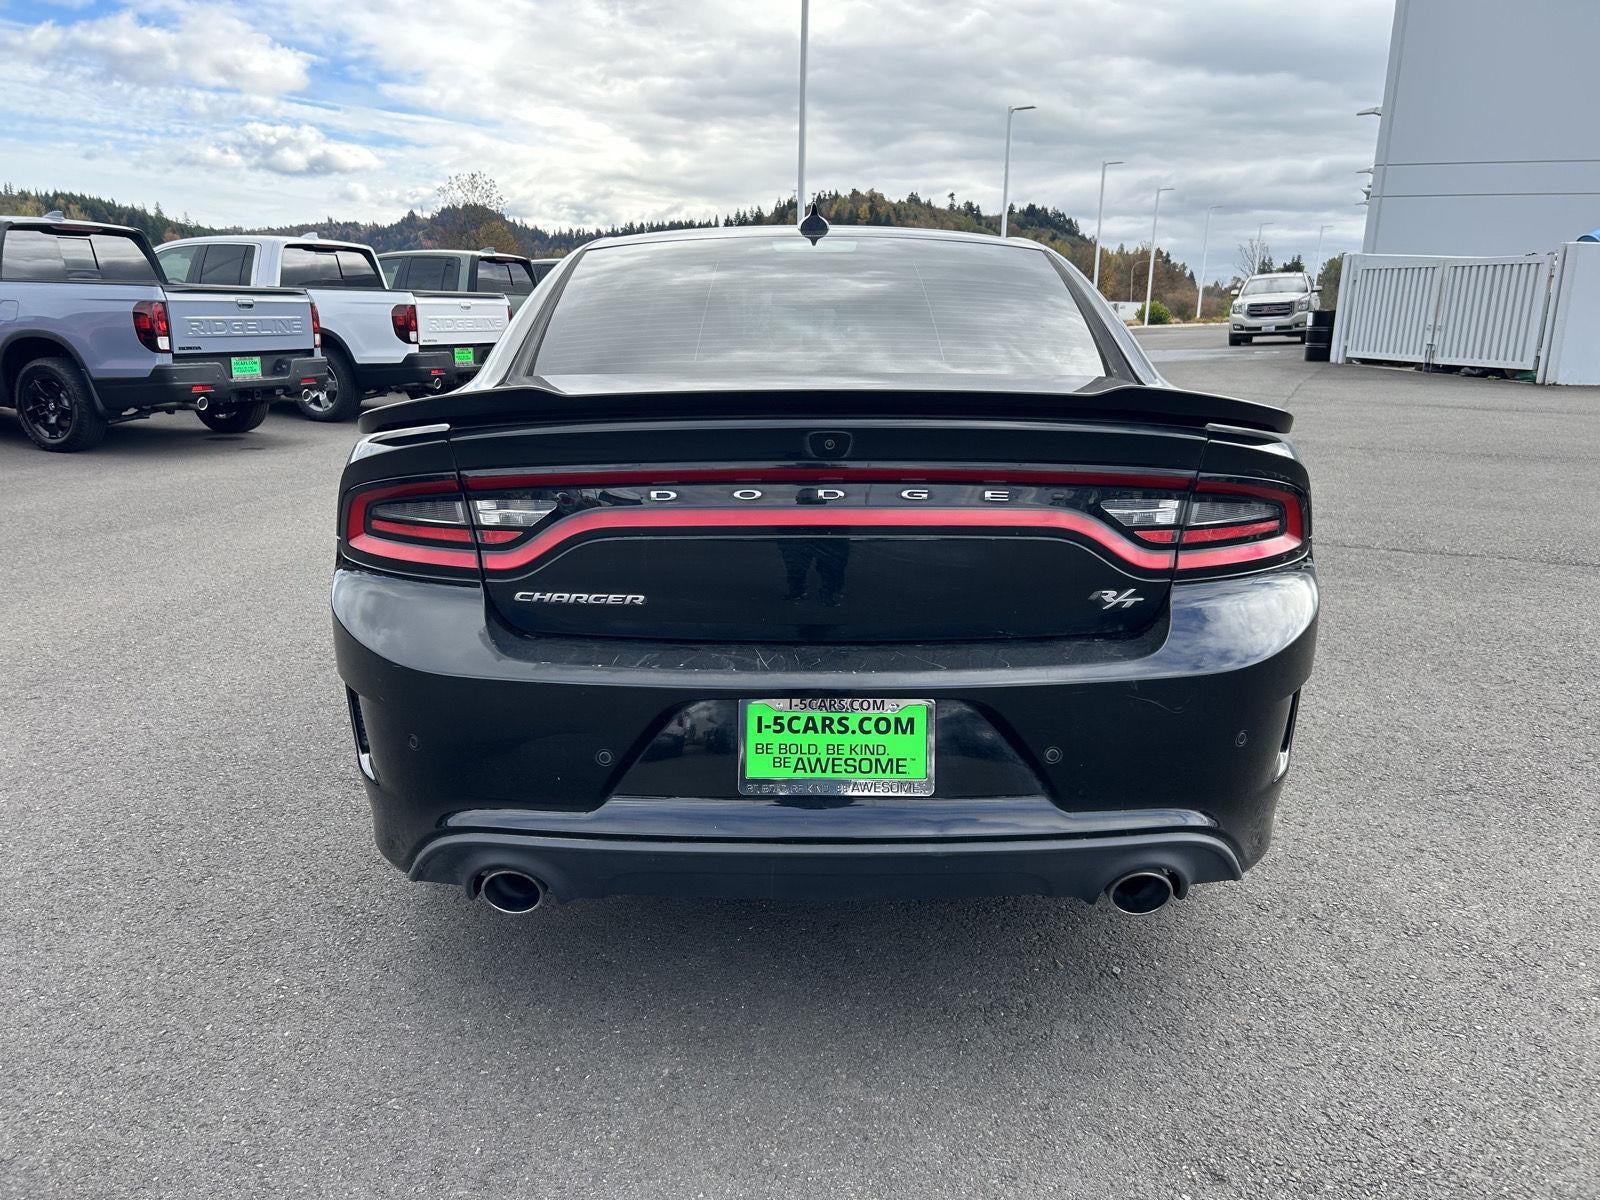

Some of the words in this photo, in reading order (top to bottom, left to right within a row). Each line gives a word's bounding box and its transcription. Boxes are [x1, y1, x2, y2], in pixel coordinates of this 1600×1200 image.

[188, 319, 303, 335] RIDGELINE
[428, 318, 504, 331] RIDGELINE
[650, 489, 1010, 501] DODGE
[514, 591, 645, 605] CHARGER
[1099, 588, 1145, 610] R/T
[788, 699, 886, 712] I-5CARS.COM
[756, 715, 915, 735] I-5CARS.COM
[755, 743, 774, 755] BE
[778, 743, 821, 756] BOLD.
[826, 743, 845, 755] BE
[849, 744, 890, 756] KIND.
[772, 756, 792, 768] BE
